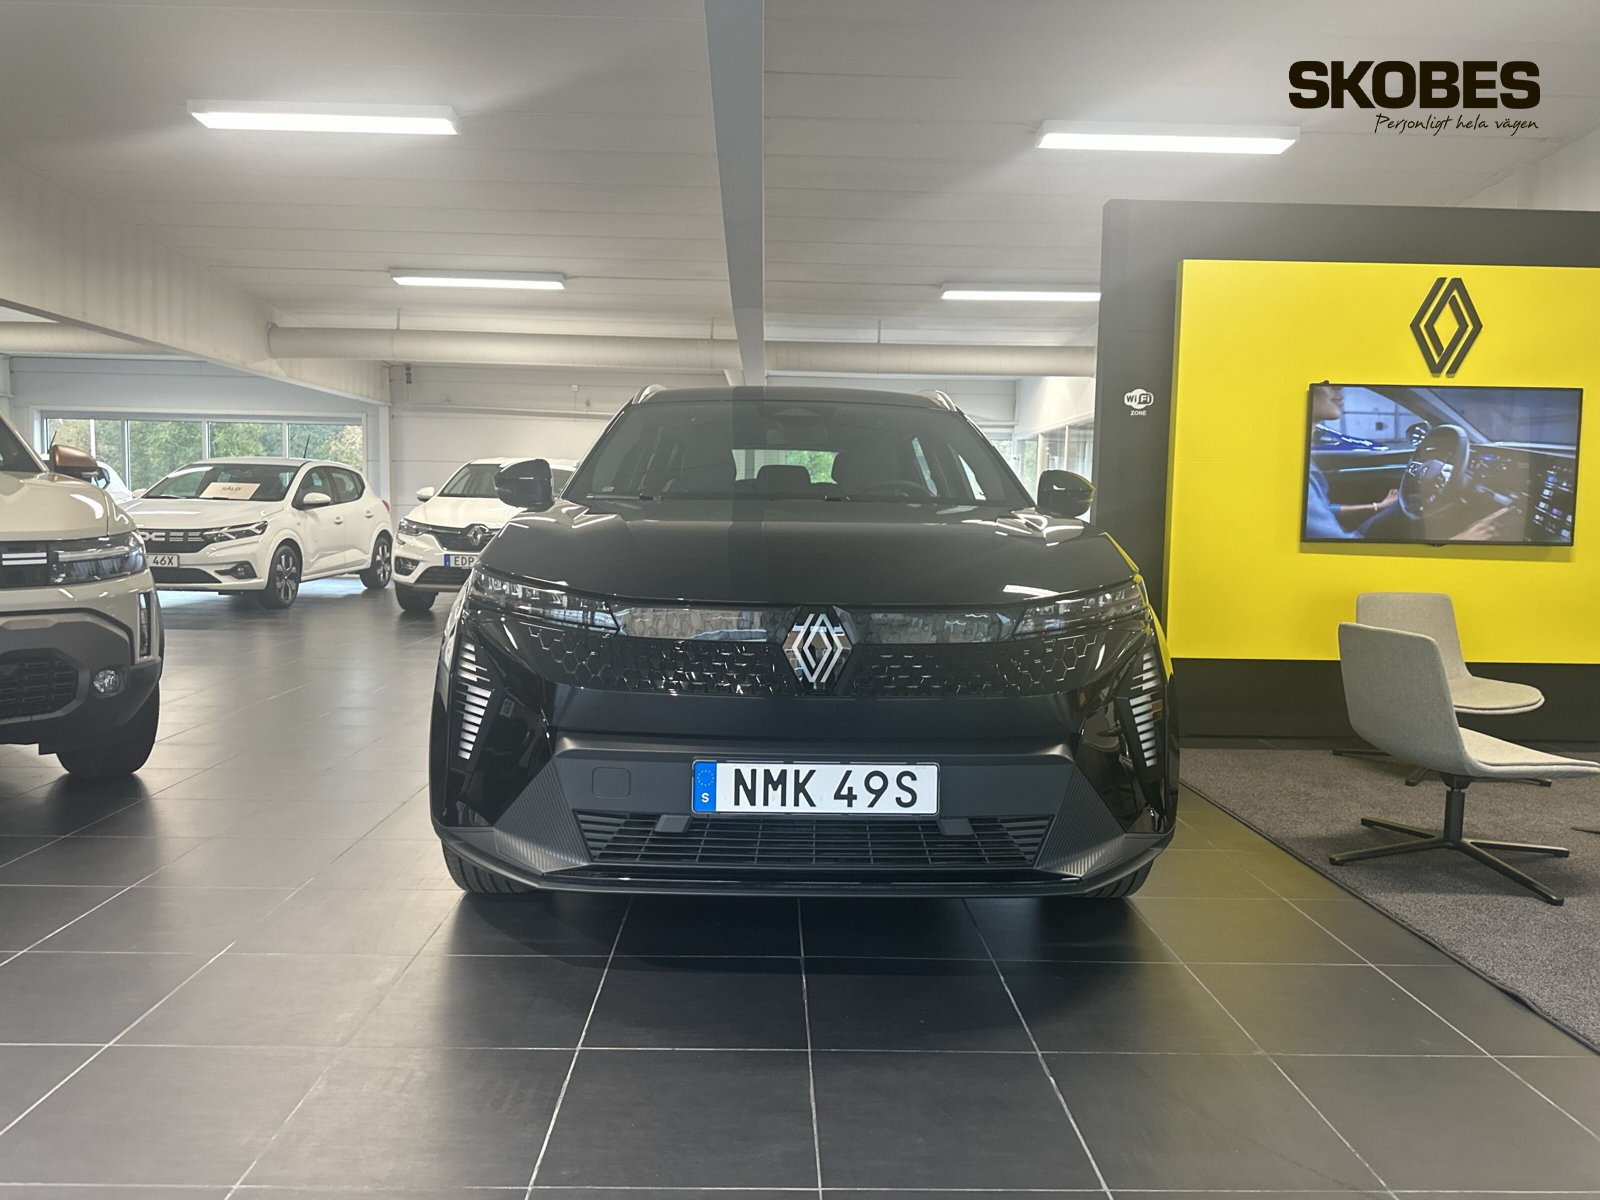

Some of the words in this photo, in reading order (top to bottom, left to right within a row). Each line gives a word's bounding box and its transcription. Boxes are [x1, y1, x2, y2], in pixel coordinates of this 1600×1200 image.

[153, 555, 174, 566] 46X
[454, 556, 475, 566] EDP
[733, 768, 817, 807] NMK
[833, 770, 918, 808] 49S
[701, 792, 710, 803] S
